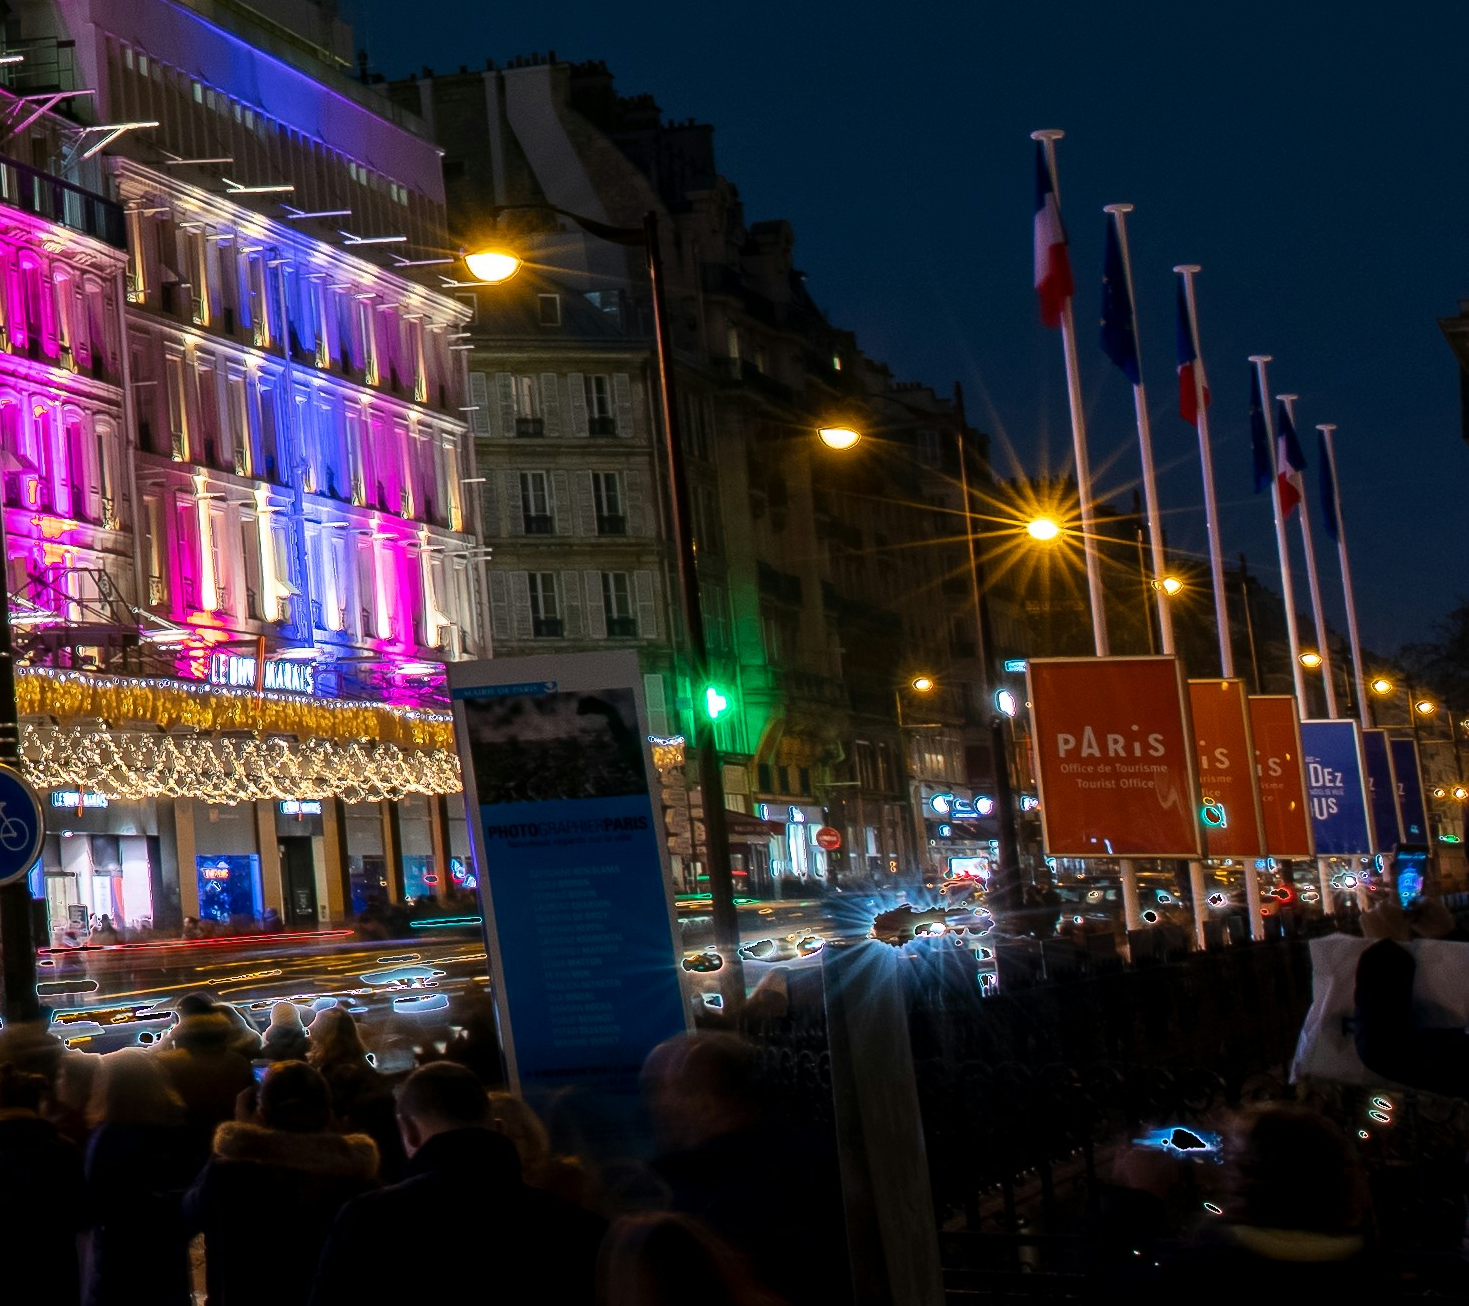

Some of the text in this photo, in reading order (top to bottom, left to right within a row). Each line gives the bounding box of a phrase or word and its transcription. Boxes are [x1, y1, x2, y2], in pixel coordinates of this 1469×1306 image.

[1060, 763, 1168, 774] Office de Tourisme
[1075, 778, 1155, 789] Tourist Office
